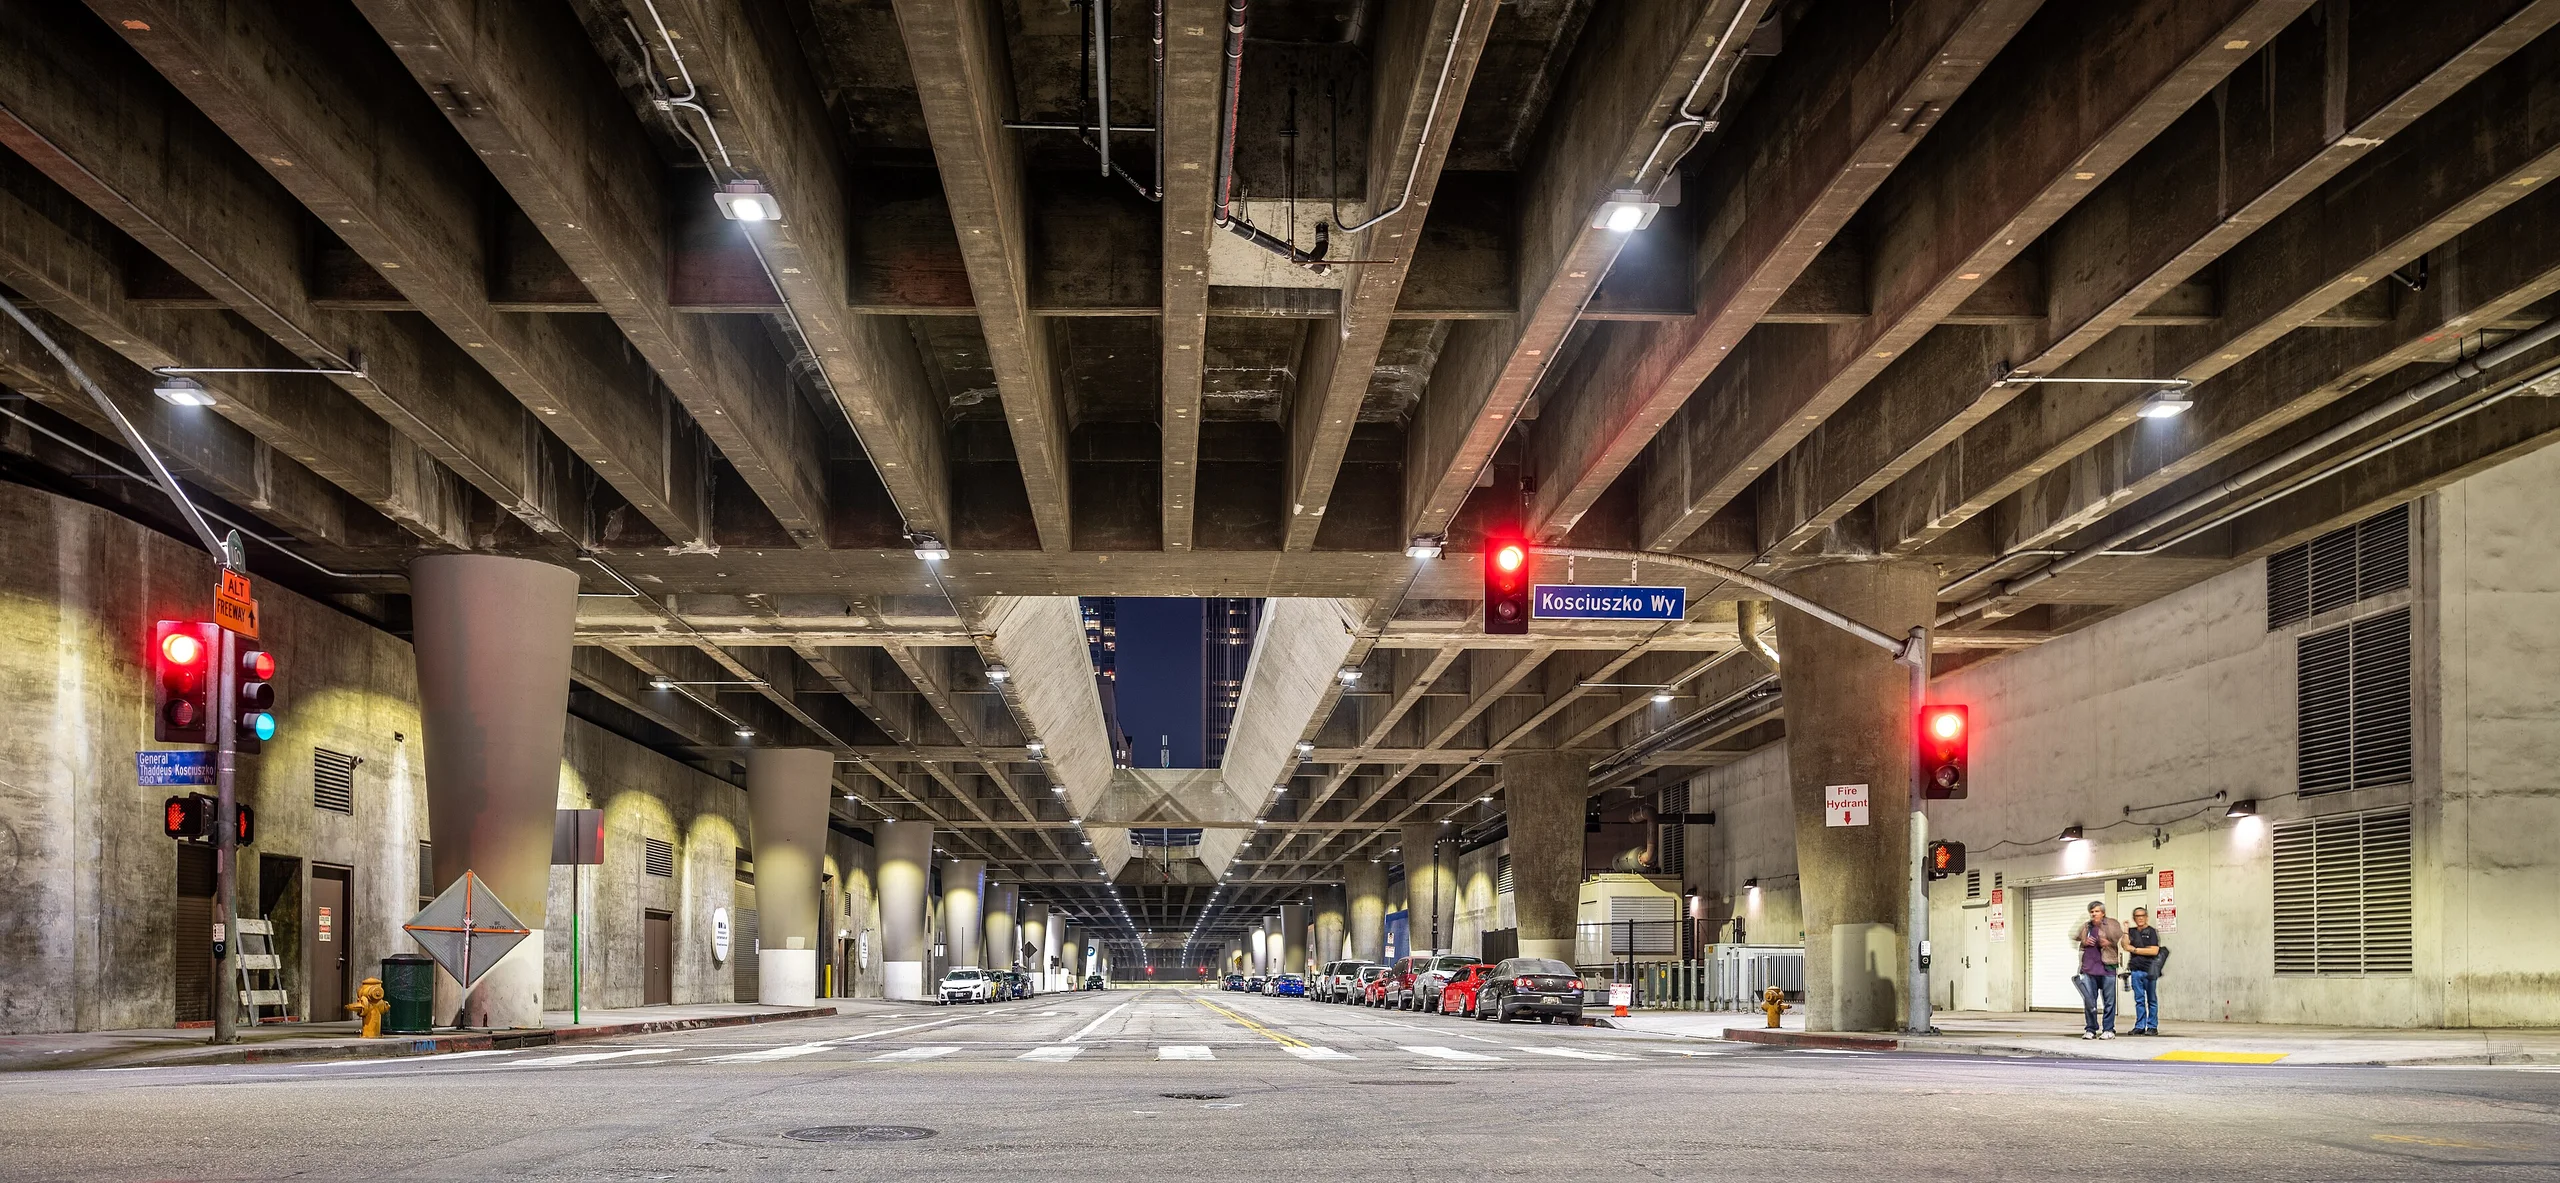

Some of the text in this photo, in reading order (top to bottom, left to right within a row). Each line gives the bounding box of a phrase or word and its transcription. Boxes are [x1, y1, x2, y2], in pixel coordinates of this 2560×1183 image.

[228, 579, 244, 597] ALT
[217, 598, 246, 622] FREEWAY
[1542, 592, 1676, 616] Kosciuszko Wy
[140, 753, 168, 765] General
[140, 764, 214, 776] Thaddeus Kosciuszko
[140, 776, 154, 784] 500
[157, 776, 163, 784] W
[1837, 787, 1858, 795] Fire
[1827, 799, 1868, 810] Hydrant
[2127, 878, 2137, 887] 225
